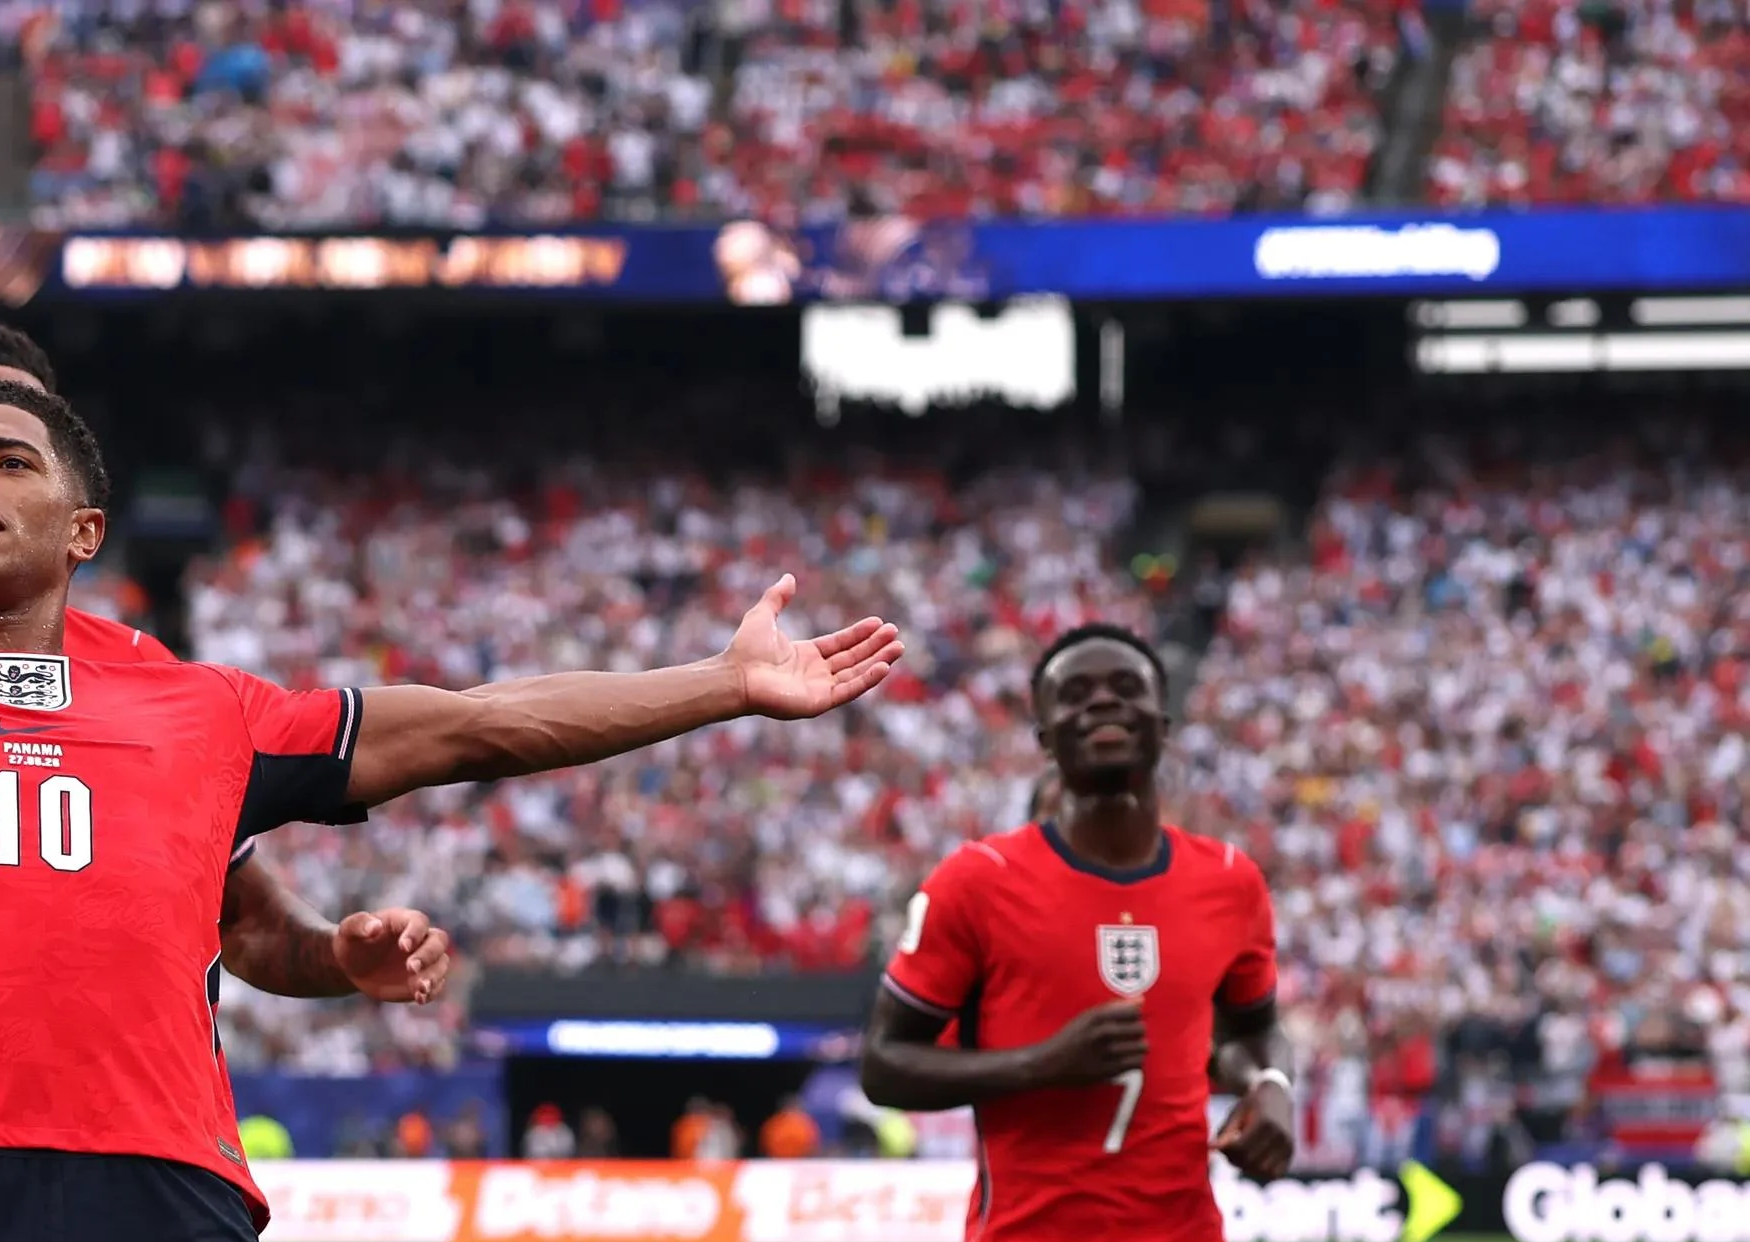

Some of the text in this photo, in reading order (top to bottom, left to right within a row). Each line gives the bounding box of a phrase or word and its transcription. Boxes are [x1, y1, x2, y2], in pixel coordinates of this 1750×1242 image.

[3, 742, 63, 756] PANAMA
[1102, 1068, 1144, 1154] 7
[479, 1165, 718, 1236] Betano
